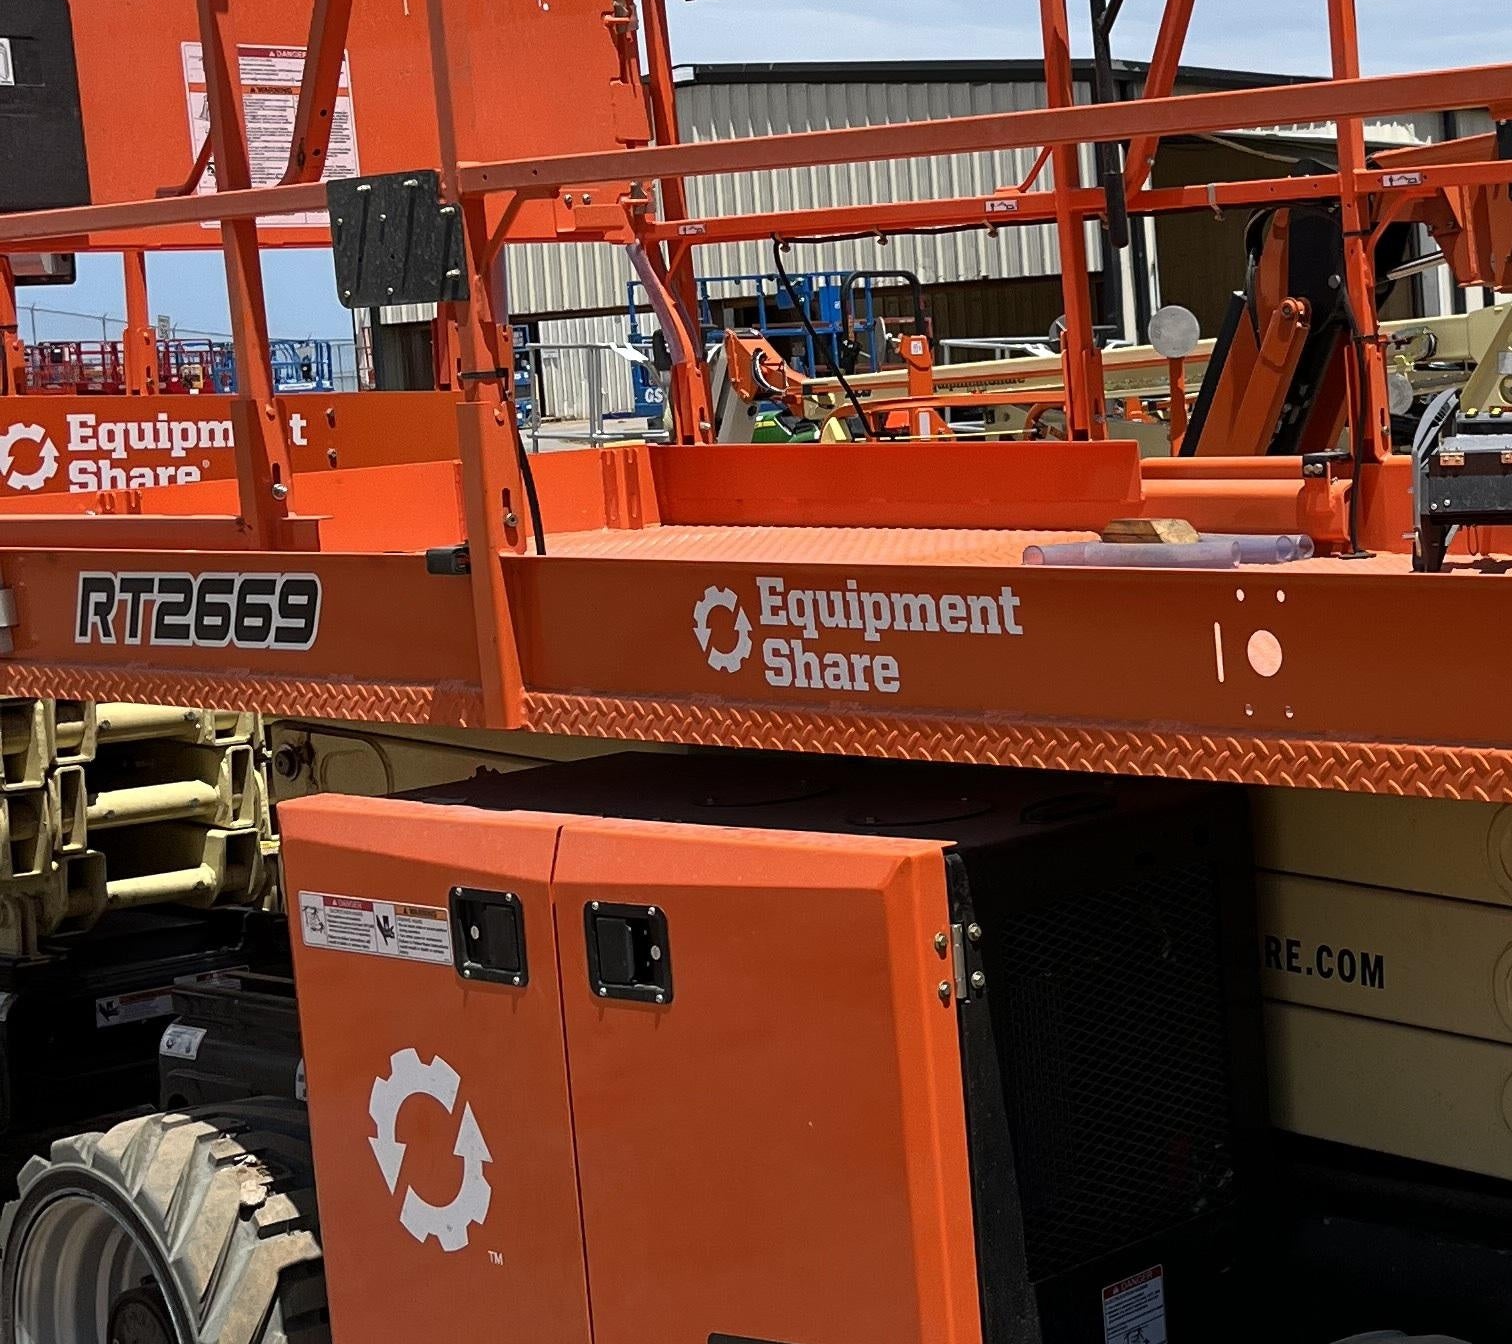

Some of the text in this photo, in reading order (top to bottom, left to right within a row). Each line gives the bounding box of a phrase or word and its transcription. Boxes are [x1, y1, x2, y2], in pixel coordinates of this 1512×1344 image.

[66, 413, 308, 458] Equipmt
[69, 459, 200, 494] Share
[75, 571, 322, 651] RT2669
[756, 576, 1024, 642] Equipment
[762, 639, 900, 693] Share
